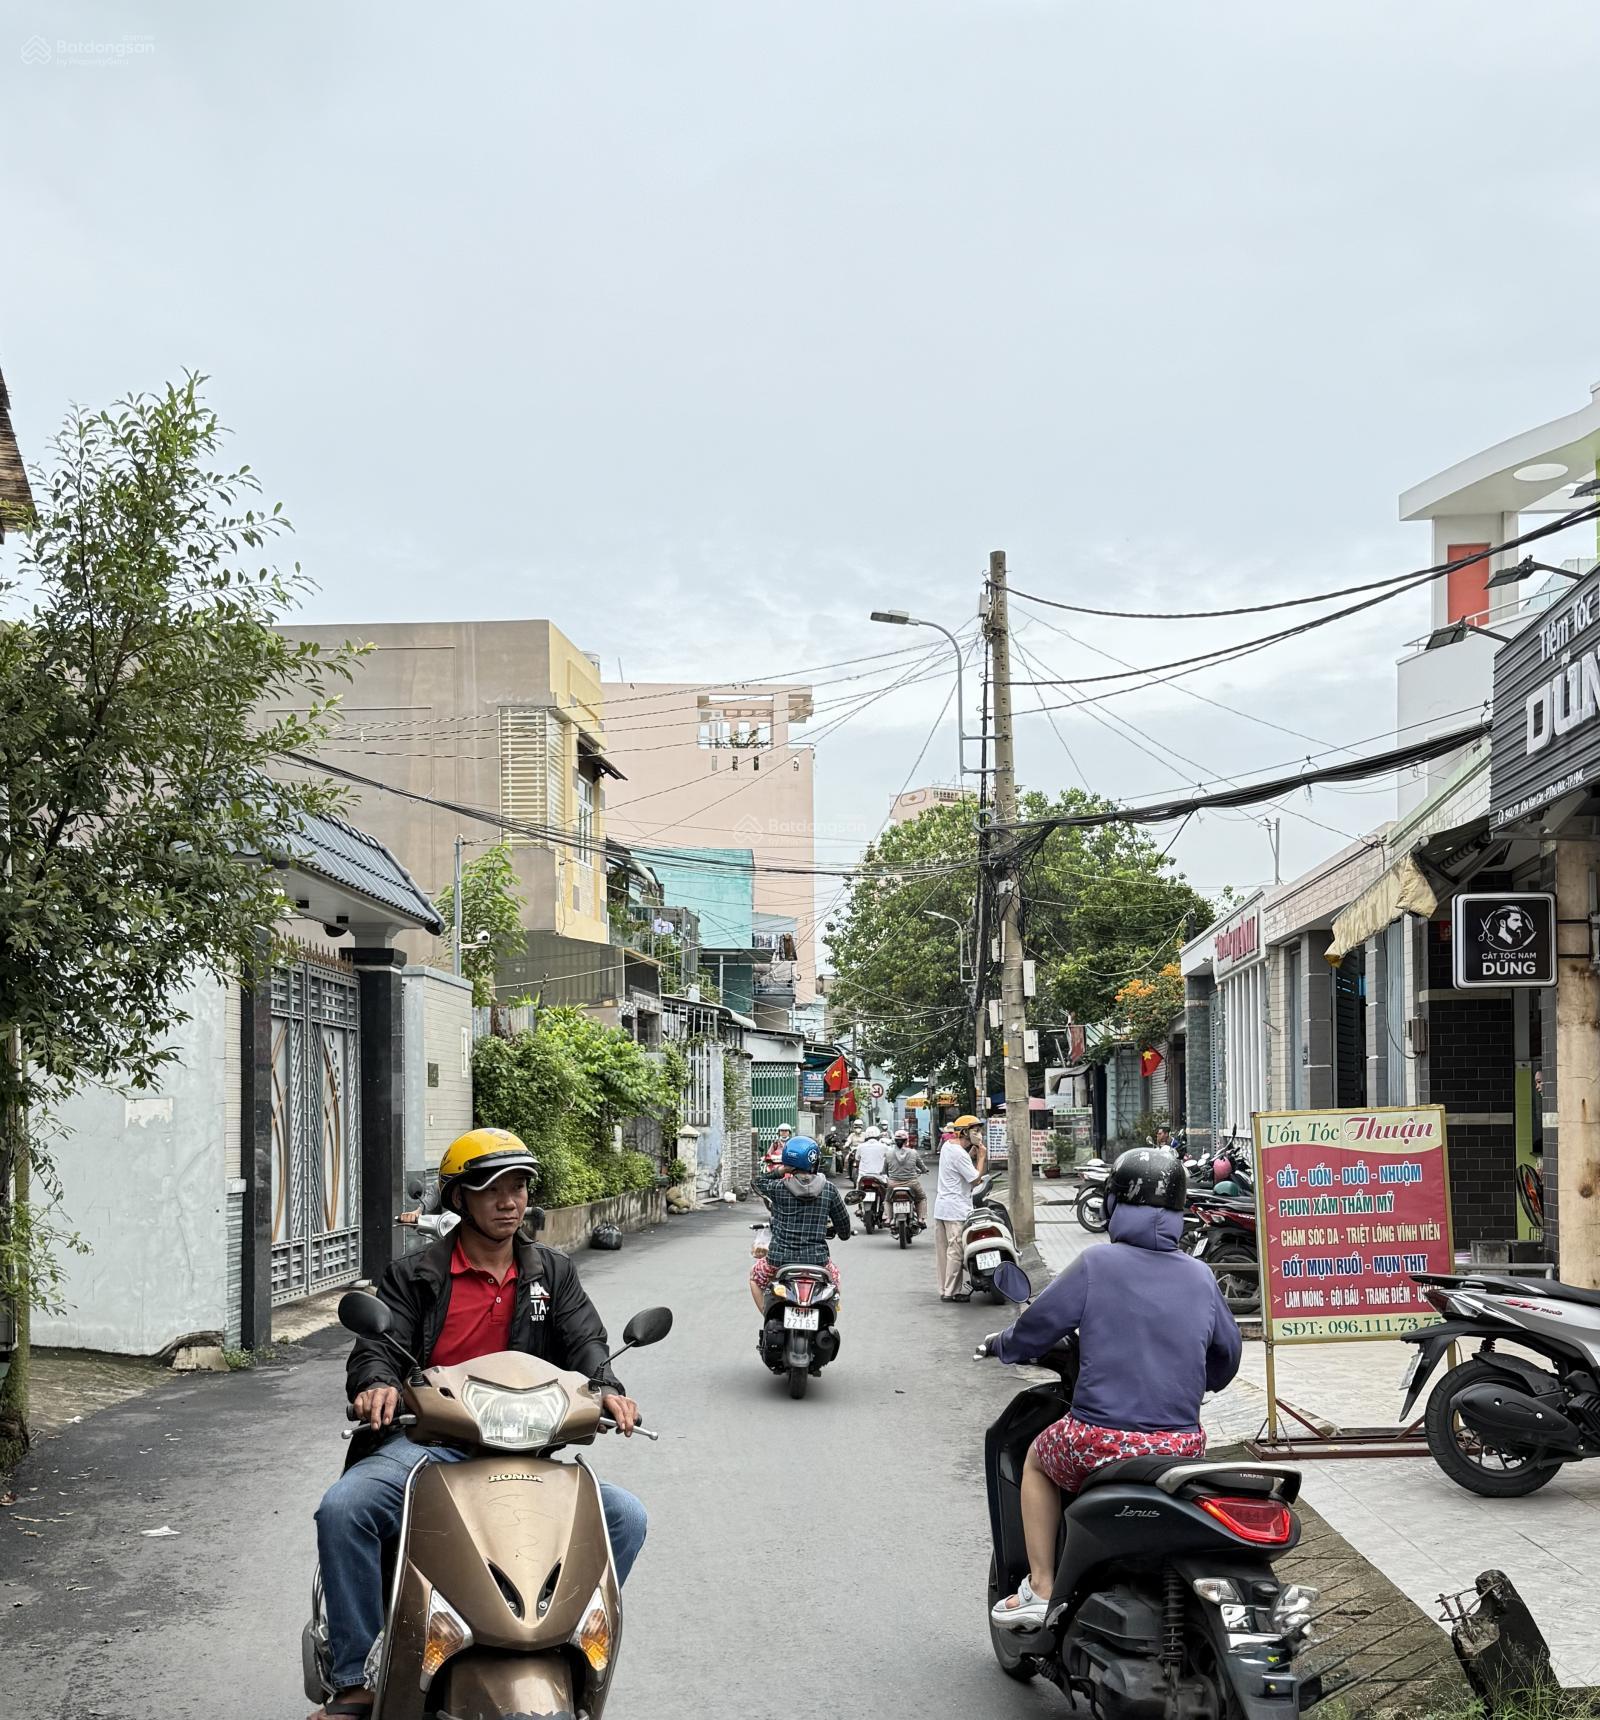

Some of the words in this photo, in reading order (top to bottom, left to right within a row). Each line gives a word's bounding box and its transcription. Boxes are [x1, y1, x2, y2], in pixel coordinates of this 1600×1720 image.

[1540, 617, 1569, 662] Tiệm
[1572, 593, 1594, 635] Tóc
[1482, 959, 1536, 975] DŨNG
[1266, 1121, 1301, 1144] Uốn
[1307, 1120, 1340, 1142] Tóc
[1344, 1116, 1433, 1145] Thuận
[1277, 1164, 1298, 1187] CẮT
[1308, 1162, 1332, 1186] UỐN
[1341, 1160, 1369, 1185] DUỖI
[1379, 1161, 1423, 1187] NHUỘM
[1279, 1198, 1311, 1217] PHUN
[1312, 1194, 1340, 1216] XĂM
[1341, 1189, 1374, 1214] THẨM
[1376, 1190, 1395, 1213] MỸ
[1280, 1226, 1306, 1247] CHĂM
[1307, 1225, 1325, 1246] SÓC
[1326, 1227, 1339, 1245] DA
[1346, 1223, 1370, 1247] TRIỆT
[1371, 1222, 1396, 1243] LÔNG
[1396, 1222, 1418, 1242] VĨNH
[1419, 1217, 1441, 1241] VIỄN
[1282, 1254, 1304, 1278] ĐỐT
[1306, 1258, 1334, 1280] MỤN
[1373, 1255, 1401, 1277] MỤN
[1402, 1254, 1428, 1275] THỊT
[1284, 1287, 1301, 1308] LÀM
[1302, 1286, 1325, 1308] MÓNG
[1330, 1286, 1343, 1310] GỘI
[1365, 1286, 1390, 1305] TRANG
[1391, 1280, 1411, 1304] ĐIỂM
[1281, 1321, 1323, 1337] SĐT:
[489, 1473, 543, 1483] HONDA
[1114, 1505, 1161, 1518] Janus
